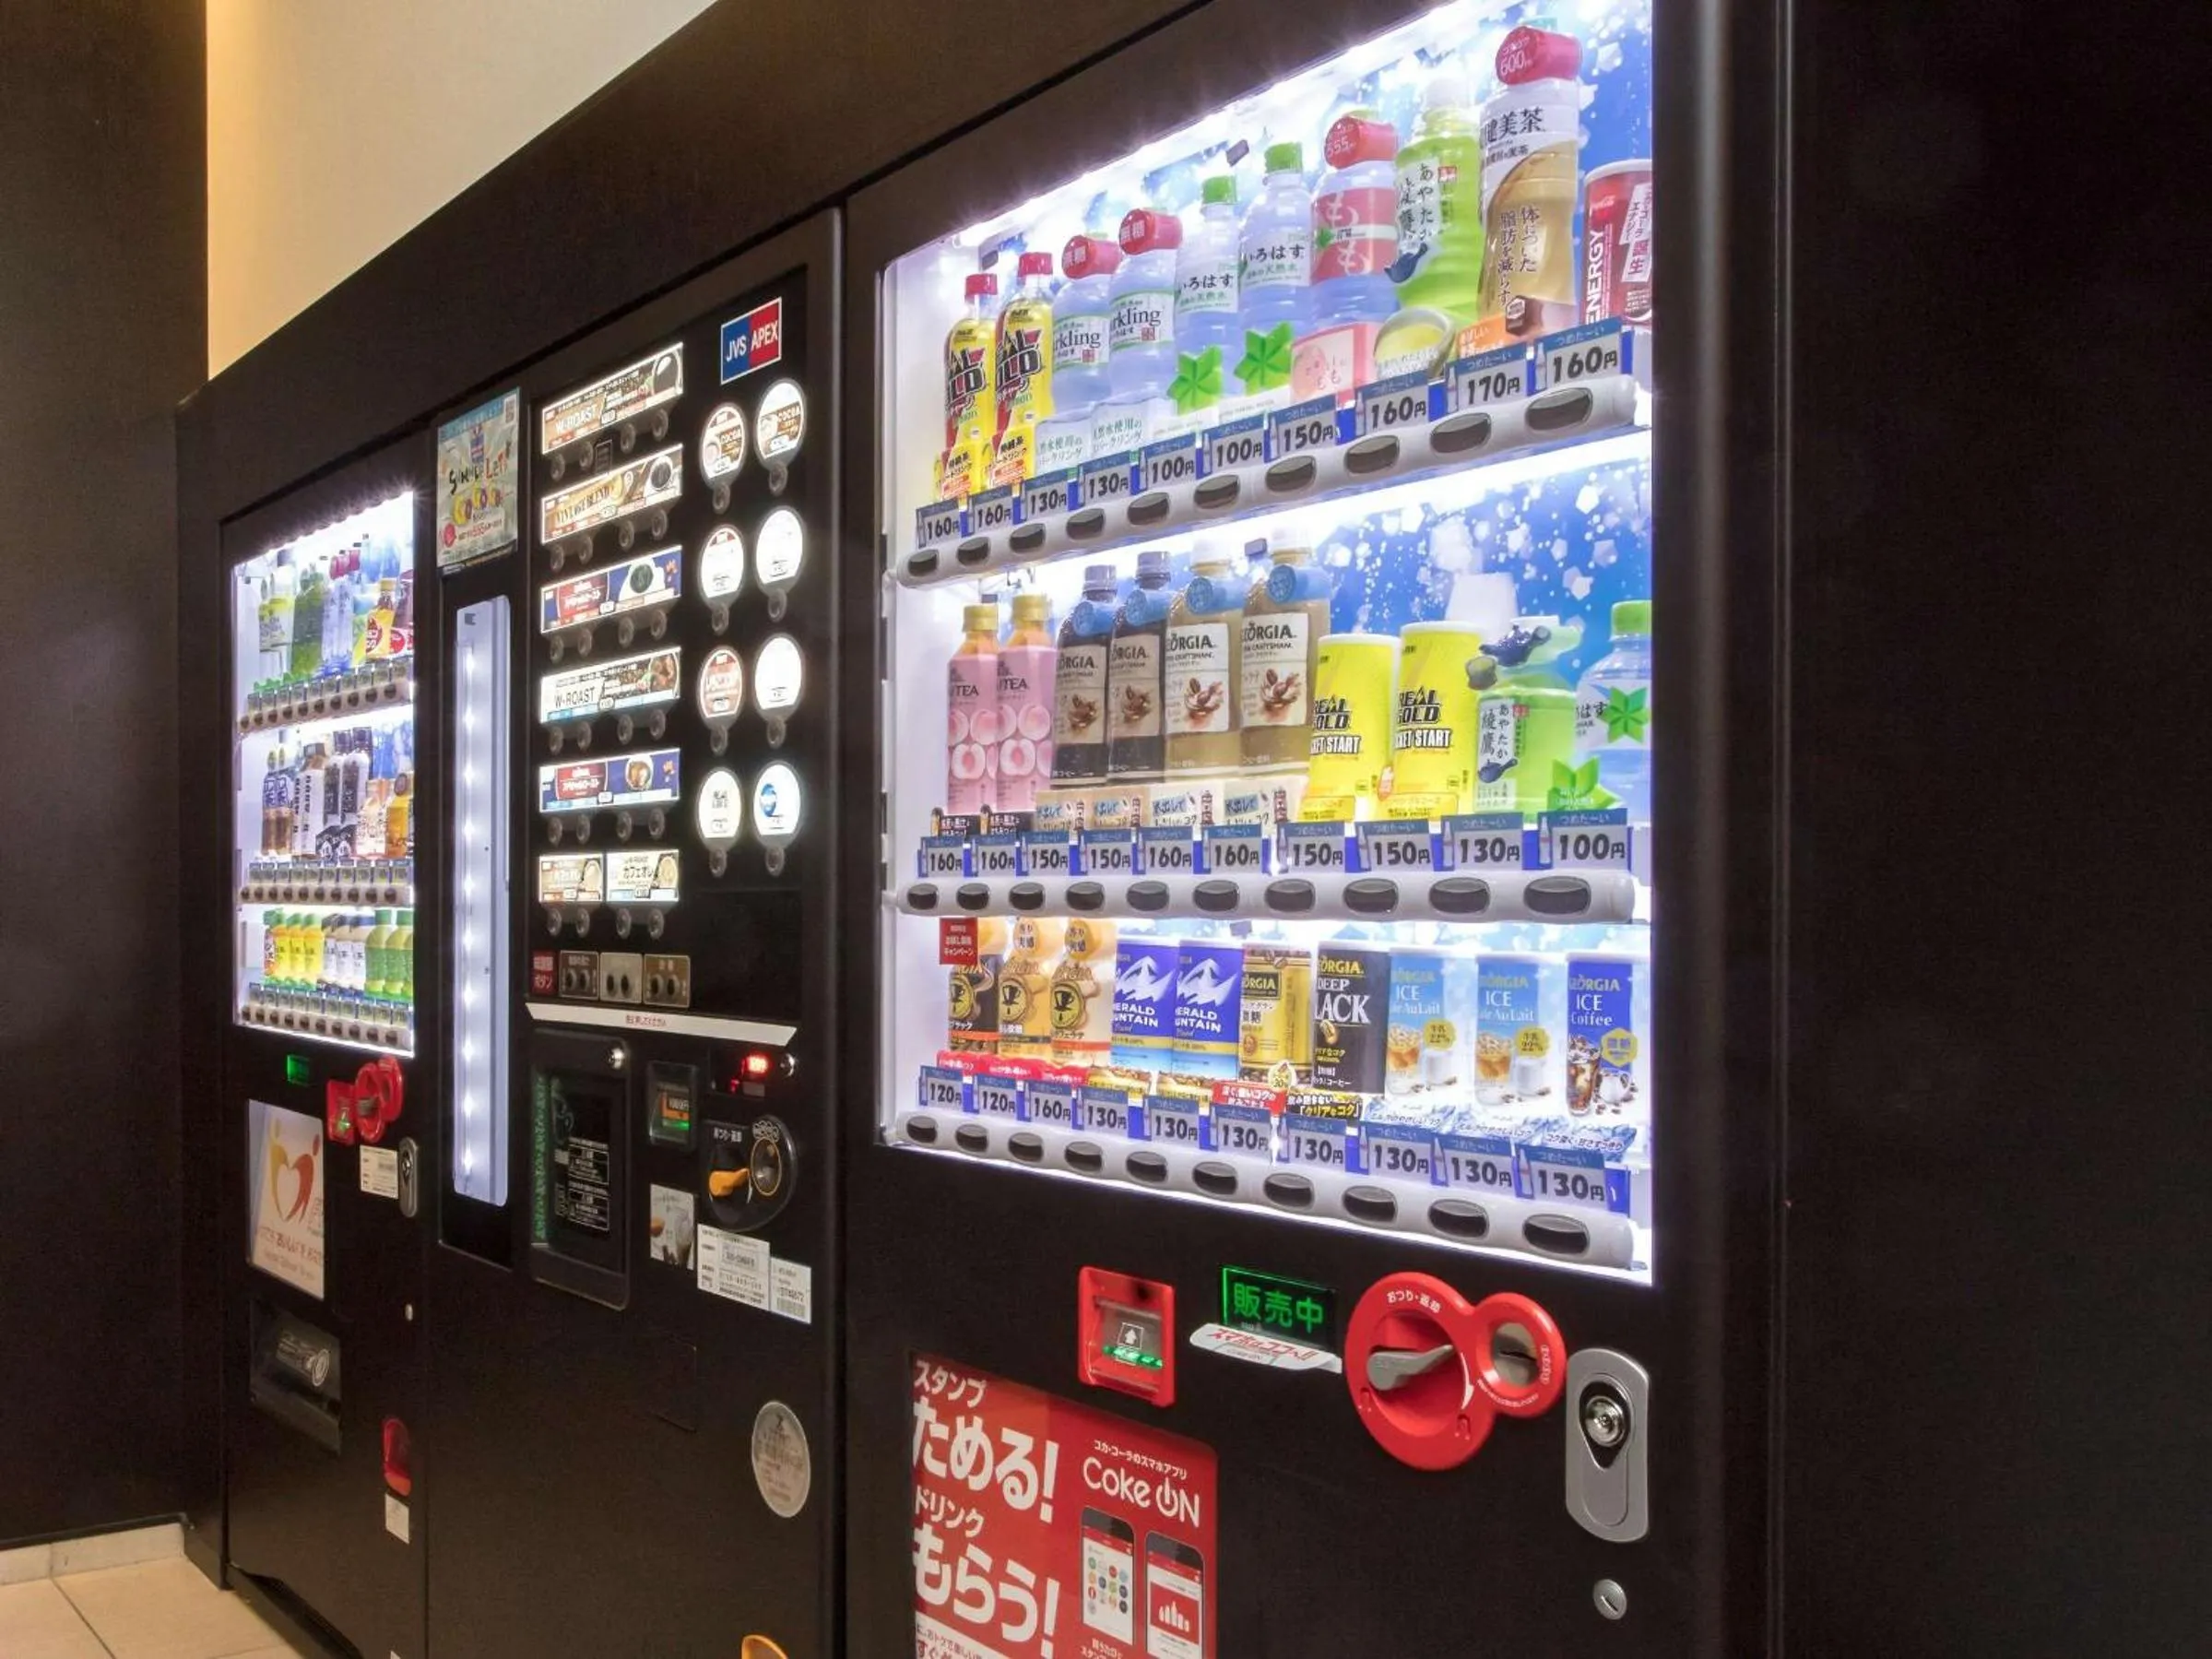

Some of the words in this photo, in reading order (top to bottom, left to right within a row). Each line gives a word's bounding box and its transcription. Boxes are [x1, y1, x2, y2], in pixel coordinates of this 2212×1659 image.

[1481, 106, 1545, 148] 健美茶
[1586, 231, 1604, 326] ENERGY
[1111, 306, 1162, 331] rkling
[726, 335, 747, 363] JVS
[751, 320, 778, 352] APEX
[1054, 328, 1101, 351] rkling
[1553, 346, 1618, 383] 160円
[1467, 372, 1520, 405] 170円
[1370, 397, 1426, 429] 160円
[1283, 421, 1334, 452] 150円
[1216, 438, 1263, 468] 100円
[1151, 456, 1195, 484] 100円
[1089, 472, 1129, 499] 130円
[976, 501, 1011, 529] 160円
[1030, 489, 1067, 515] 130円
[926, 511, 960, 539] 160円
[1575, 701, 1606, 719] はす
[1326, 736, 1361, 754] START
[1415, 728, 1453, 748] START
[1031, 848, 1069, 869] 150円
[1091, 847, 1131, 869] 150円
[1149, 846, 1193, 868] 160円
[1214, 844, 1260, 867] 160円
[1293, 843, 1343, 867] 150円
[1374, 840, 1431, 866] 150円
[1460, 836, 1520, 864] 130円
[1559, 834, 1626, 860] 100円
[929, 851, 963, 871] 160円
[980, 850, 1015, 871] 160円
[1319, 956, 1365, 976] ORGIA
[1242, 975, 1276, 989] ORGIA
[1317, 978, 1351, 991] DEEP
[1396, 985, 1421, 1001] ICE
[1113, 1002, 1156, 1016] ERALD
[1314, 992, 1371, 1025] LACK
[1485, 990, 1512, 1007] ICE
[1576, 993, 1603, 1012] ICE
[1114, 1013, 1159, 1028] NTAIN
[1175, 1017, 1222, 1033] UNTAIN
[1176, 1007, 1218, 1022] ERALD
[1571, 1011, 1613, 1026] Coffee
[929, 1083, 962, 1106] 120円
[982, 1090, 1015, 1112] 120円
[1034, 1097, 1071, 1121] 160円
[1087, 1104, 1127, 1131] 130円
[1155, 1115, 1198, 1142] 130円
[1222, 1124, 1269, 1152] 130円
[1294, 1136, 1343, 1165] 130円
[1373, 1144, 1428, 1174] 130円
[1451, 1156, 1512, 1188] 130円
[1538, 1169, 1604, 1201] 130円
[1233, 1281, 1324, 1333] 販売中
[915, 1358, 987, 1408] スタンプ
[1094, 1439, 1188, 1481] コカ・コーラのスマホアプリ
[1082, 1455, 1152, 1509] Coke
[1154, 1476, 1201, 1528] ON
[915, 1485, 985, 1538] ドリンク
